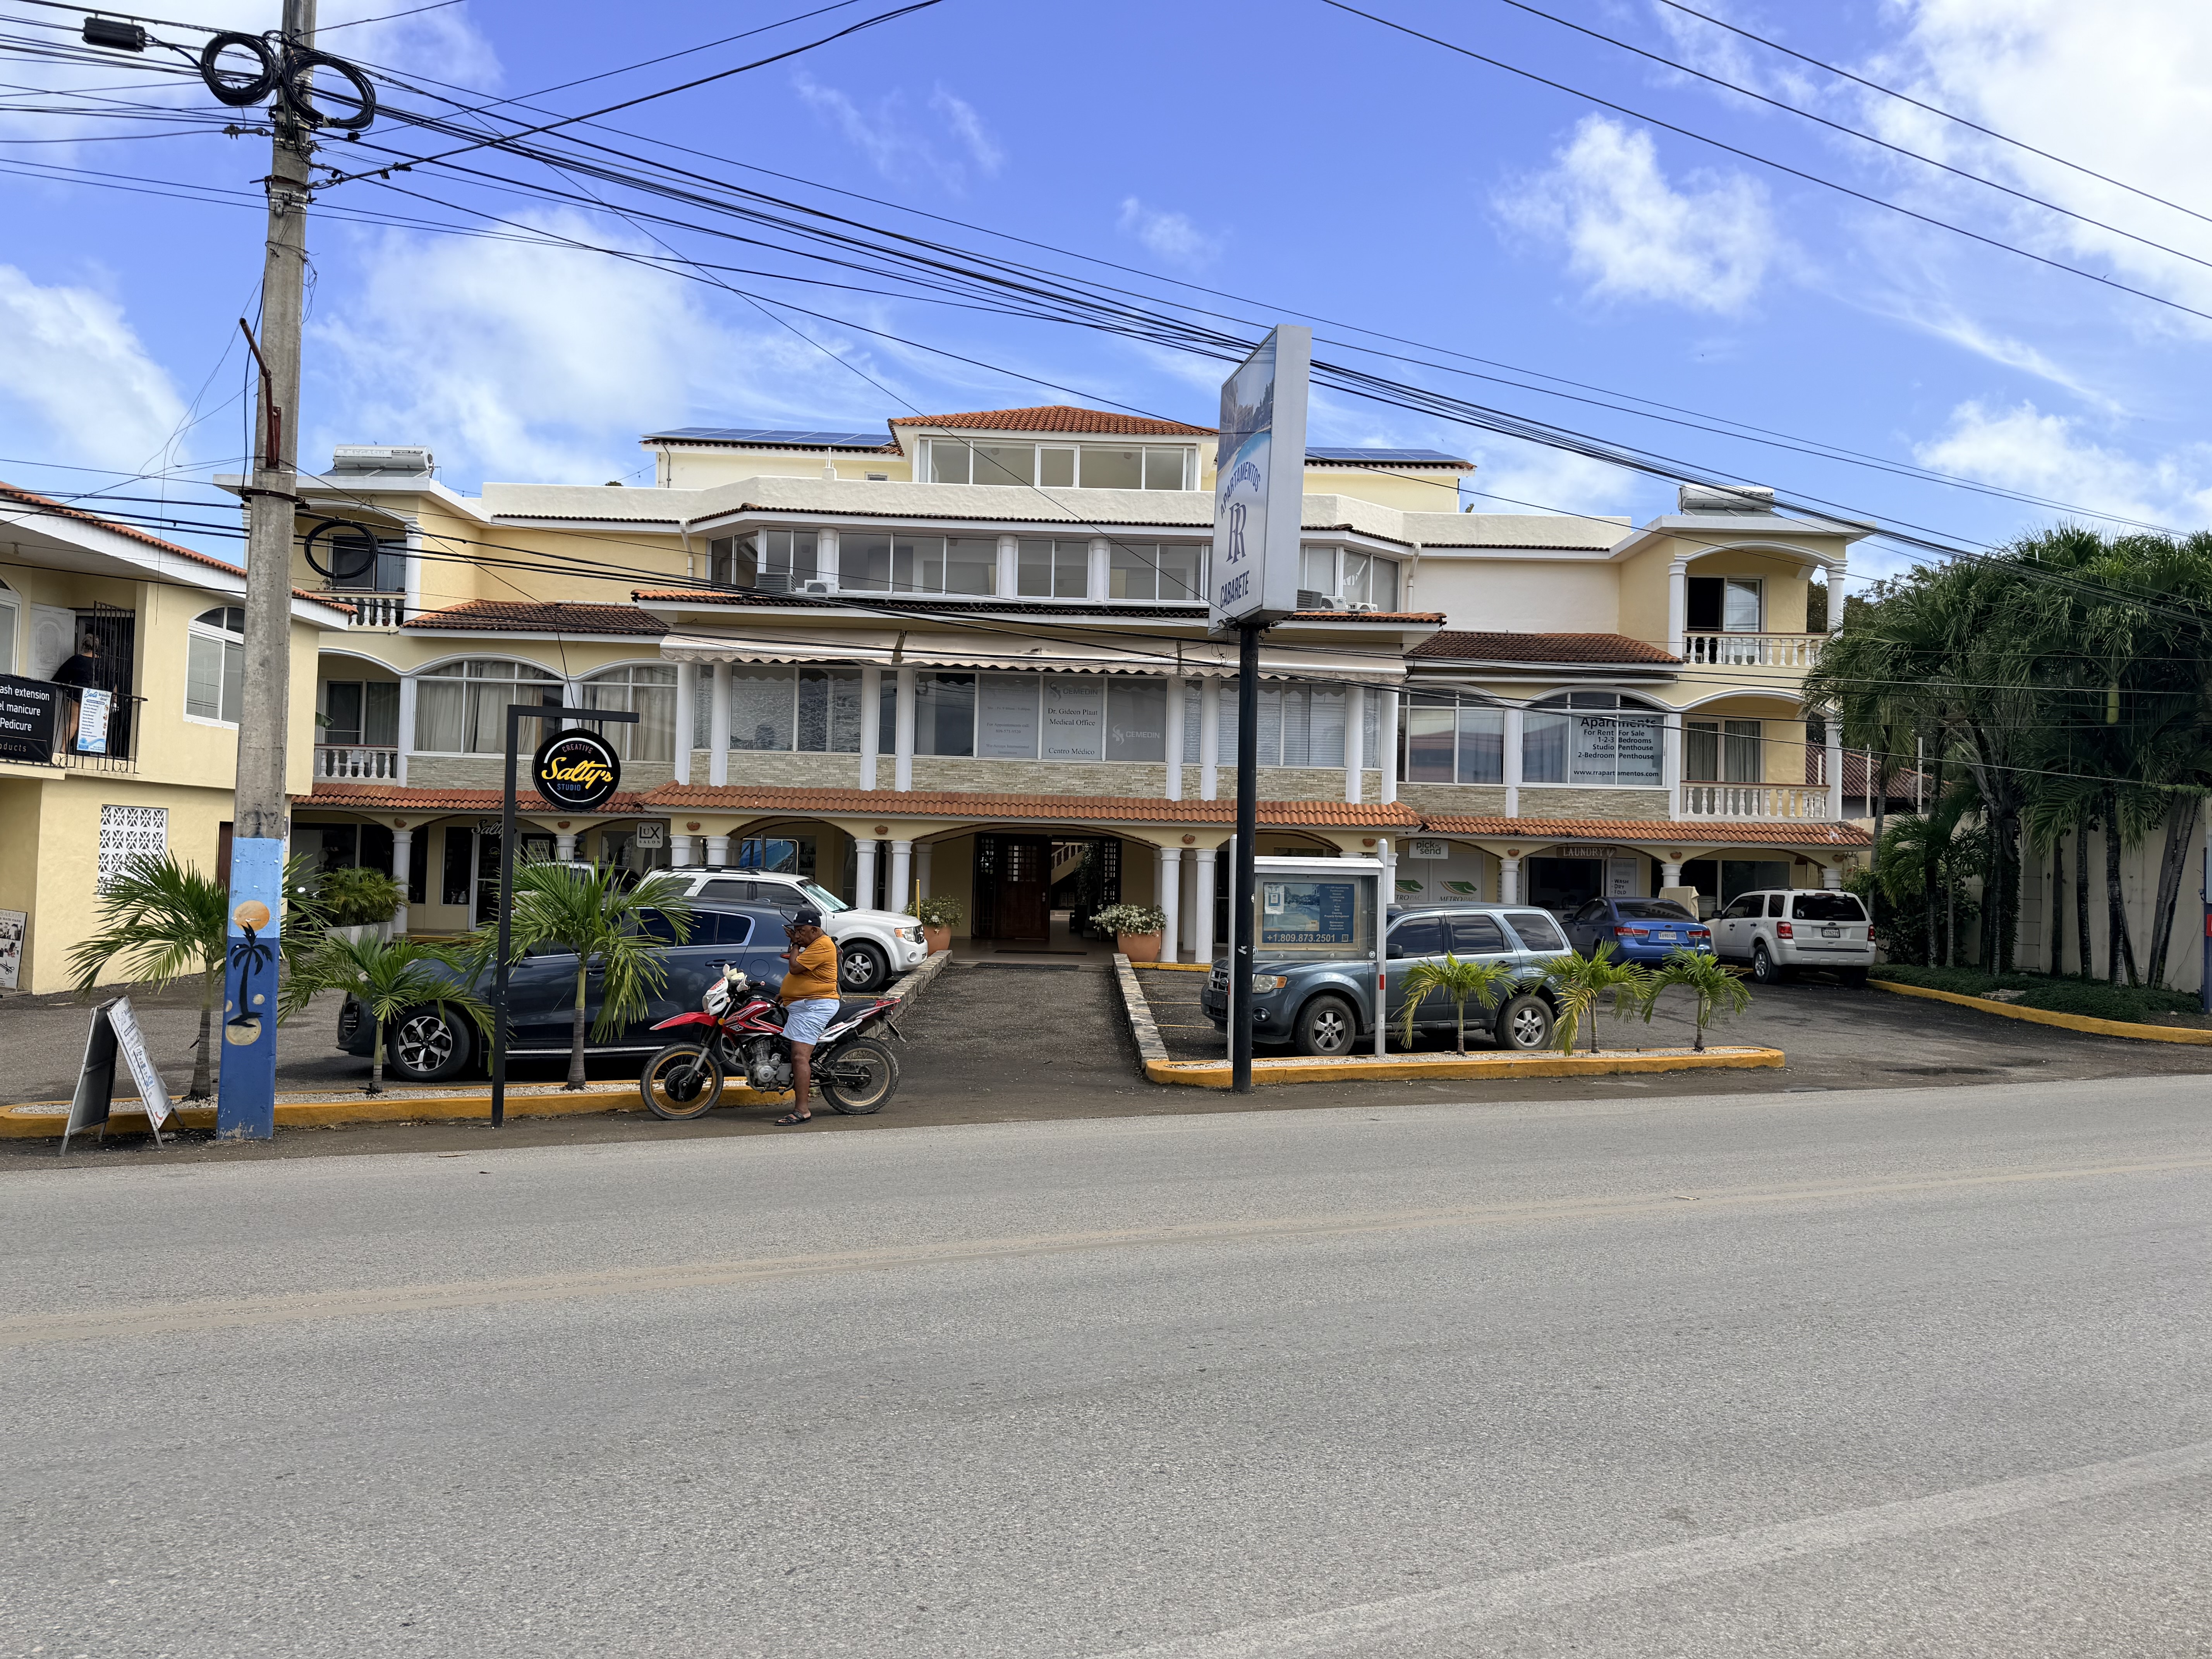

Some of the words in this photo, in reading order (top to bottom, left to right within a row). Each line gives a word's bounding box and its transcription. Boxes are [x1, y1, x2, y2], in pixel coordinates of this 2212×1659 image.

[1220, 461, 1261, 519] APARTAMENTOS
[1220, 570, 1250, 609] CABARETE
[15, 688, 50, 701] extension
[7, 704, 41, 716] manicure
[0, 718, 32, 731] Pedicure
[1580, 717, 1656, 729] Apartments
[562, 744, 593, 754] CREATIVE
[541, 757, 613, 789] Salty's
[471, 819, 503, 839] Salt
[639, 826, 660, 839] LUX
[1416, 840, 1435, 850] pick
[1563, 848, 1605, 857] LAUNDRY
[1267, 934, 1335, 942] +1.809.873.2501
